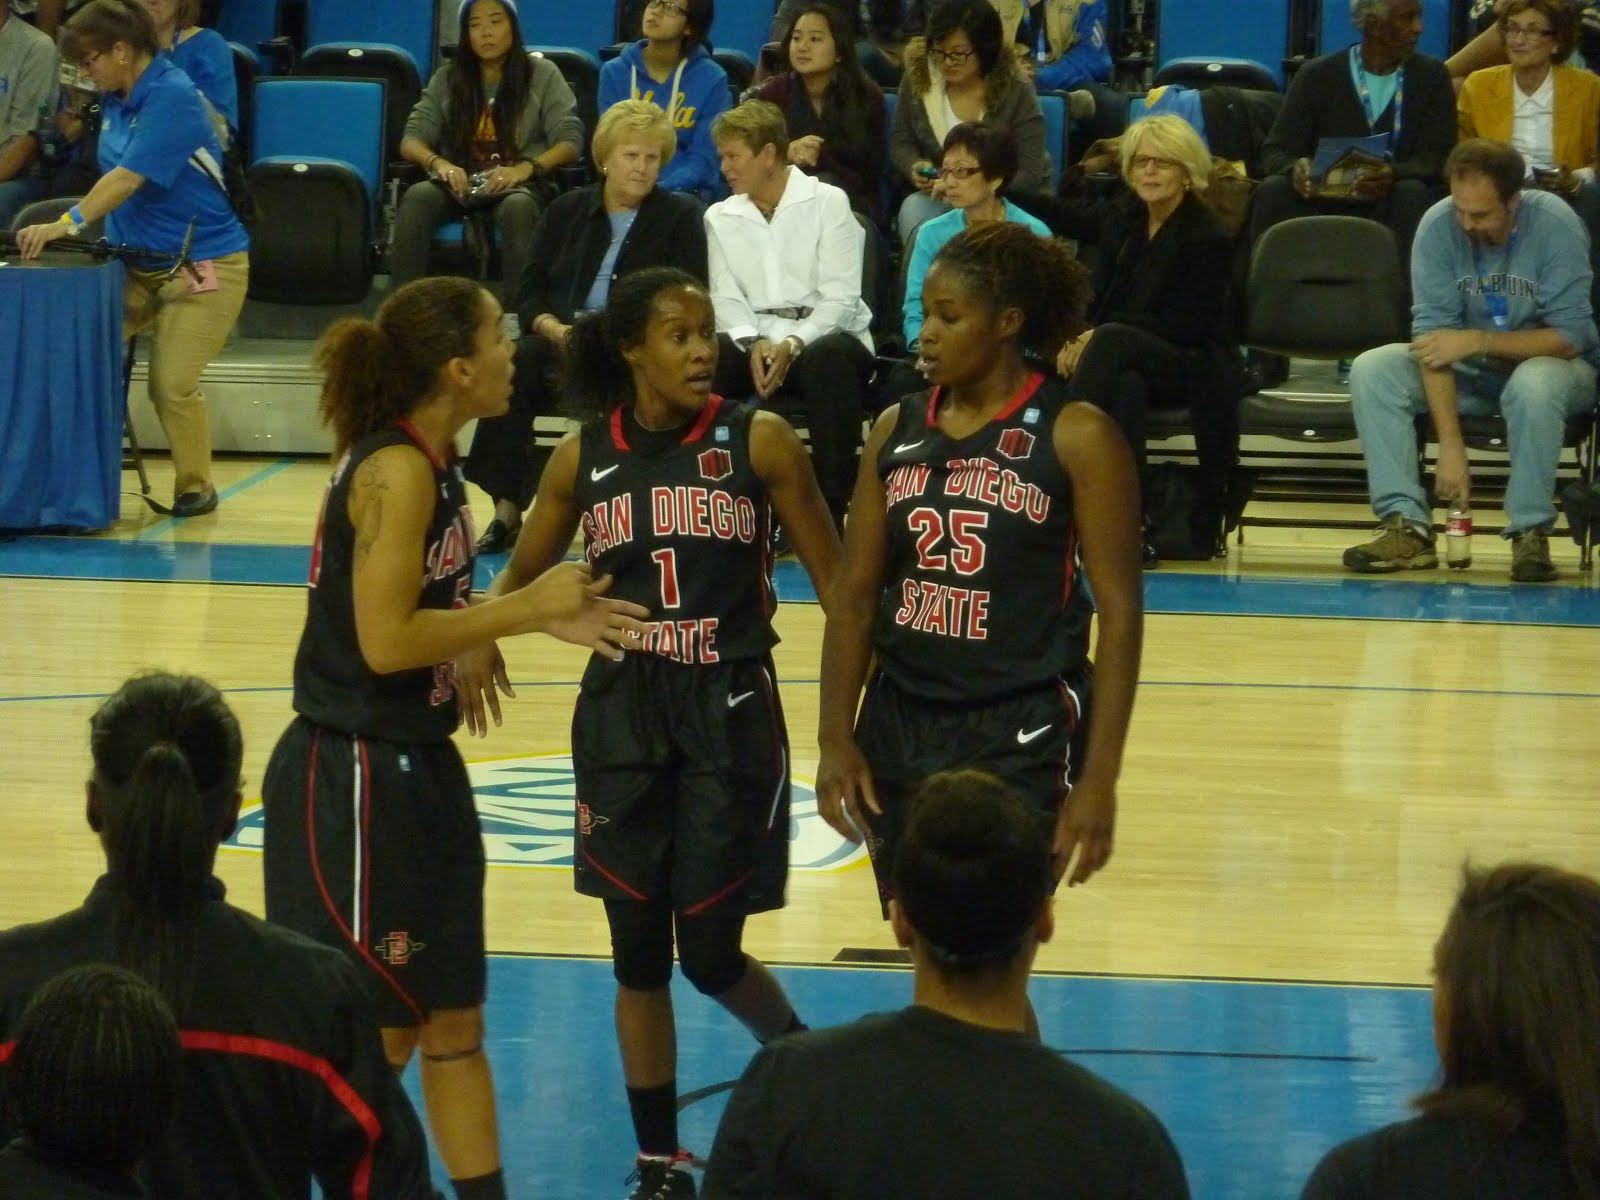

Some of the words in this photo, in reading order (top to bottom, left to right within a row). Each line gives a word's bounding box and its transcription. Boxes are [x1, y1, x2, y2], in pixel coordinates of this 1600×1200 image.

[583, 492, 633, 558] SAN
[651, 486, 756, 544] DIEGO
[907, 507, 989, 576] 25
[651, 547, 681, 609] 1
[896, 577, 990, 640] STATE
